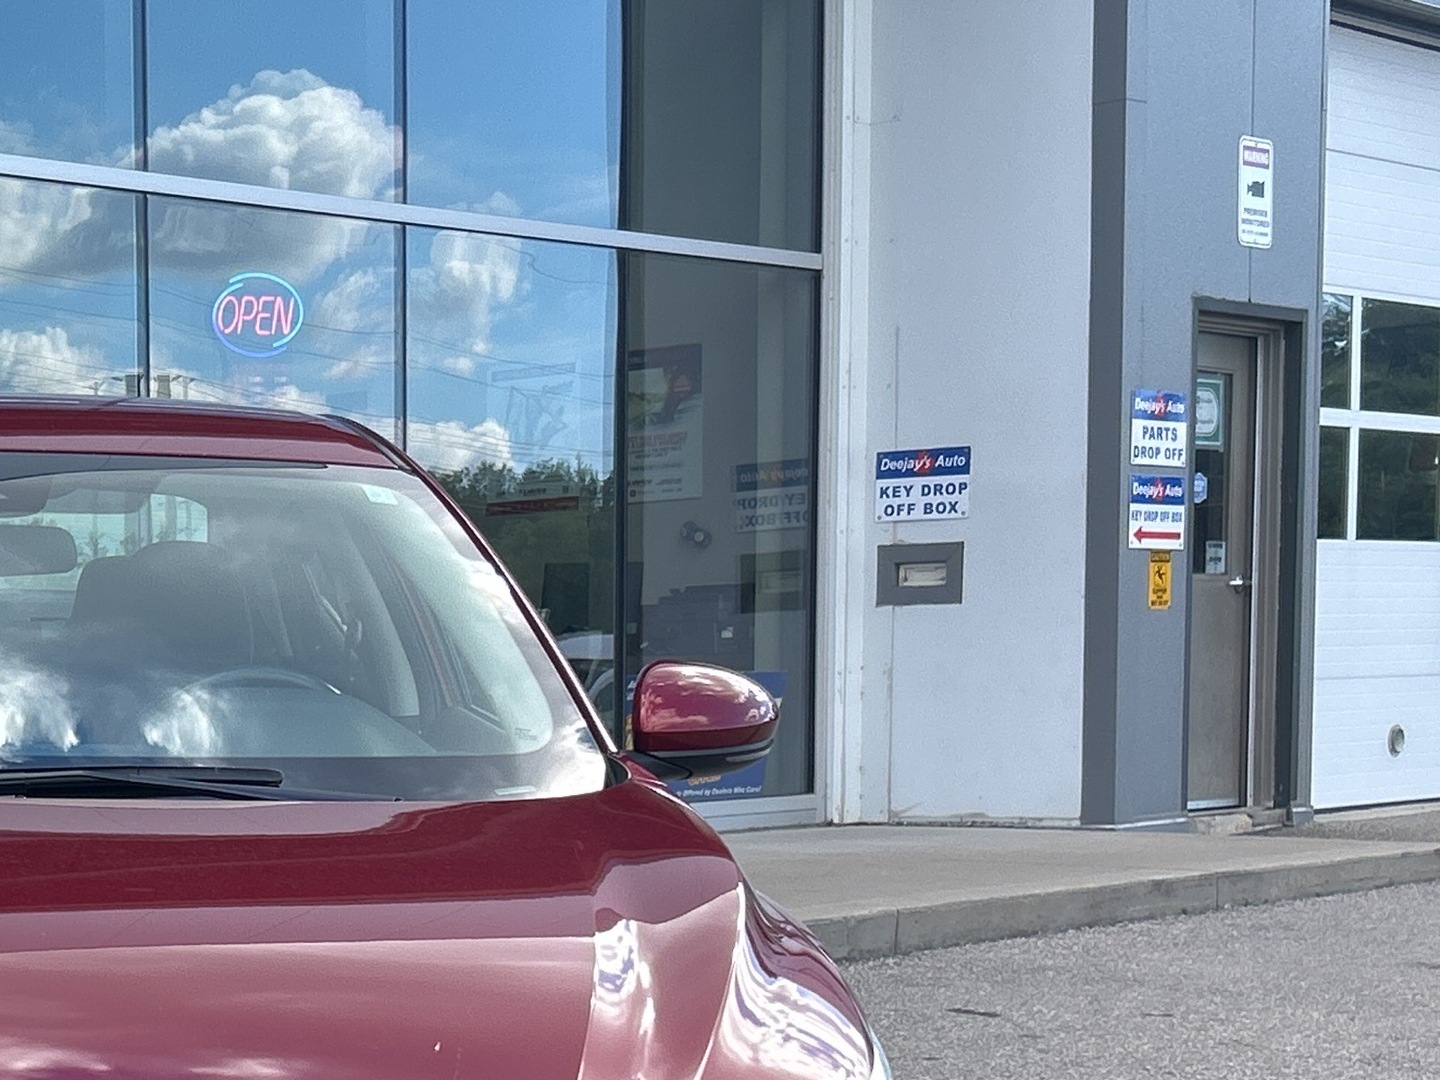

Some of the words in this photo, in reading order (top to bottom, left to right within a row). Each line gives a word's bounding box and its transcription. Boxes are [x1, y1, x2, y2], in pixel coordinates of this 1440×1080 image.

[217, 295, 295, 336] OPEN
[1135, 397, 1166, 415] Deejay's
[1166, 400, 1185, 414] Auto
[1142, 425, 1177, 442] PARTS
[1133, 445, 1161, 459] DROP
[1164, 447, 1184, 461] OFF
[880, 455, 932, 473] Deejay's
[934, 454, 966, 468] Auto
[879, 484, 914, 499] KEY
[920, 481, 968, 497] DROP
[1132, 481, 1165, 499] Deejay's
[1164, 483, 1183, 497] Auto
[883, 502, 917, 517] OFF
[922, 500, 959, 515] BOX
[1131, 510, 1142, 521] KEY
